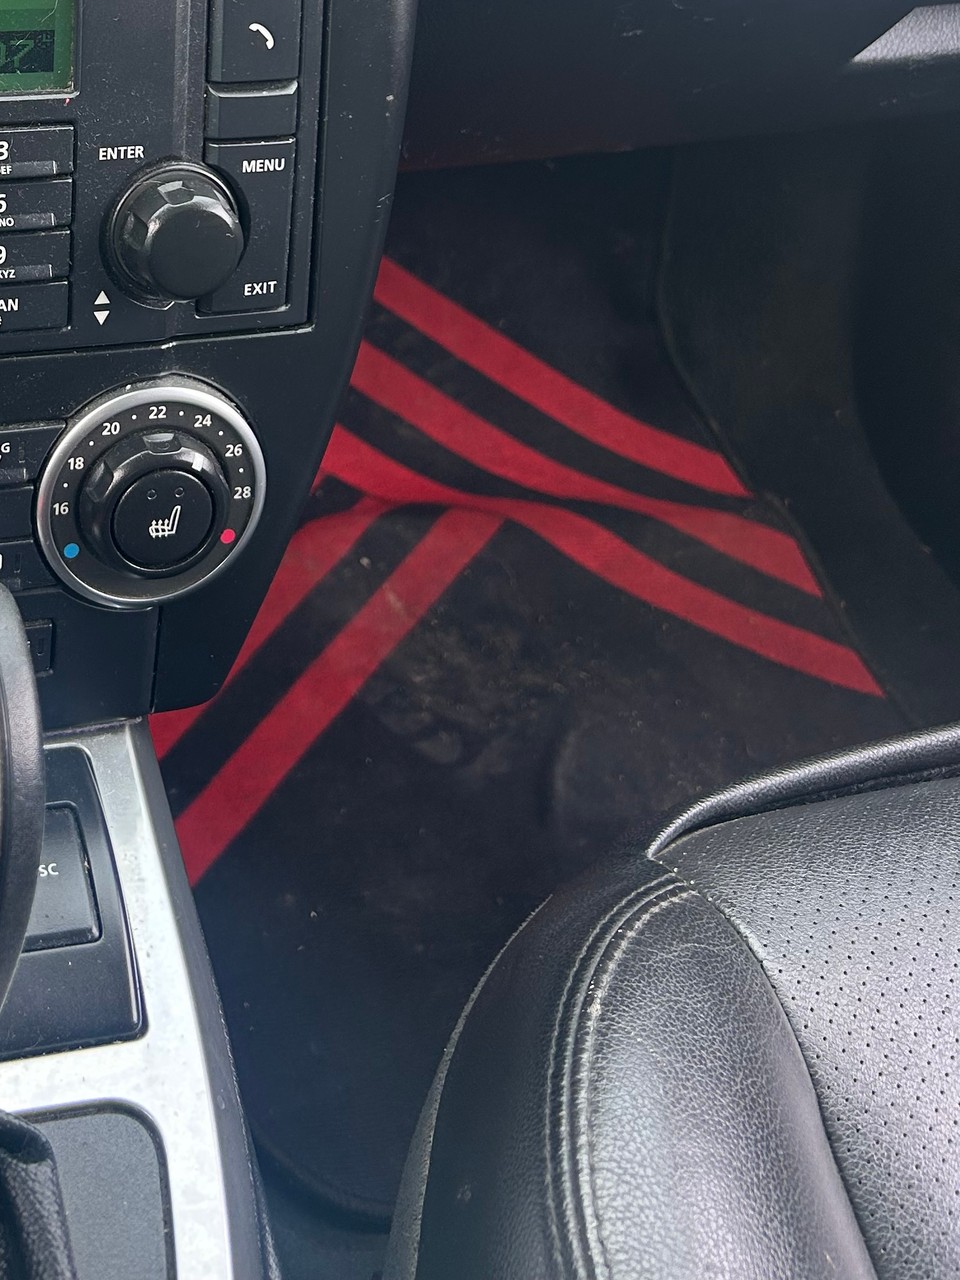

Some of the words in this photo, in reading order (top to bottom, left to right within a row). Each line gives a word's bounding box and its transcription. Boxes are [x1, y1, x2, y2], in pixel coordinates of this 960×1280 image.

[98, 145, 145, 161] ENTER
[242, 157, 285, 173] MENU
[244, 280, 278, 296] EXIT
[148, 405, 167, 420] 22
[101, 421, 121, 436] 20
[193, 414, 212, 428] 24
[224, 443, 243, 458] 26
[67, 456, 84, 471] 18
[233, 485, 252, 500] 28
[52, 501, 69, 516] 16
[38, 863, 59, 877] SC
